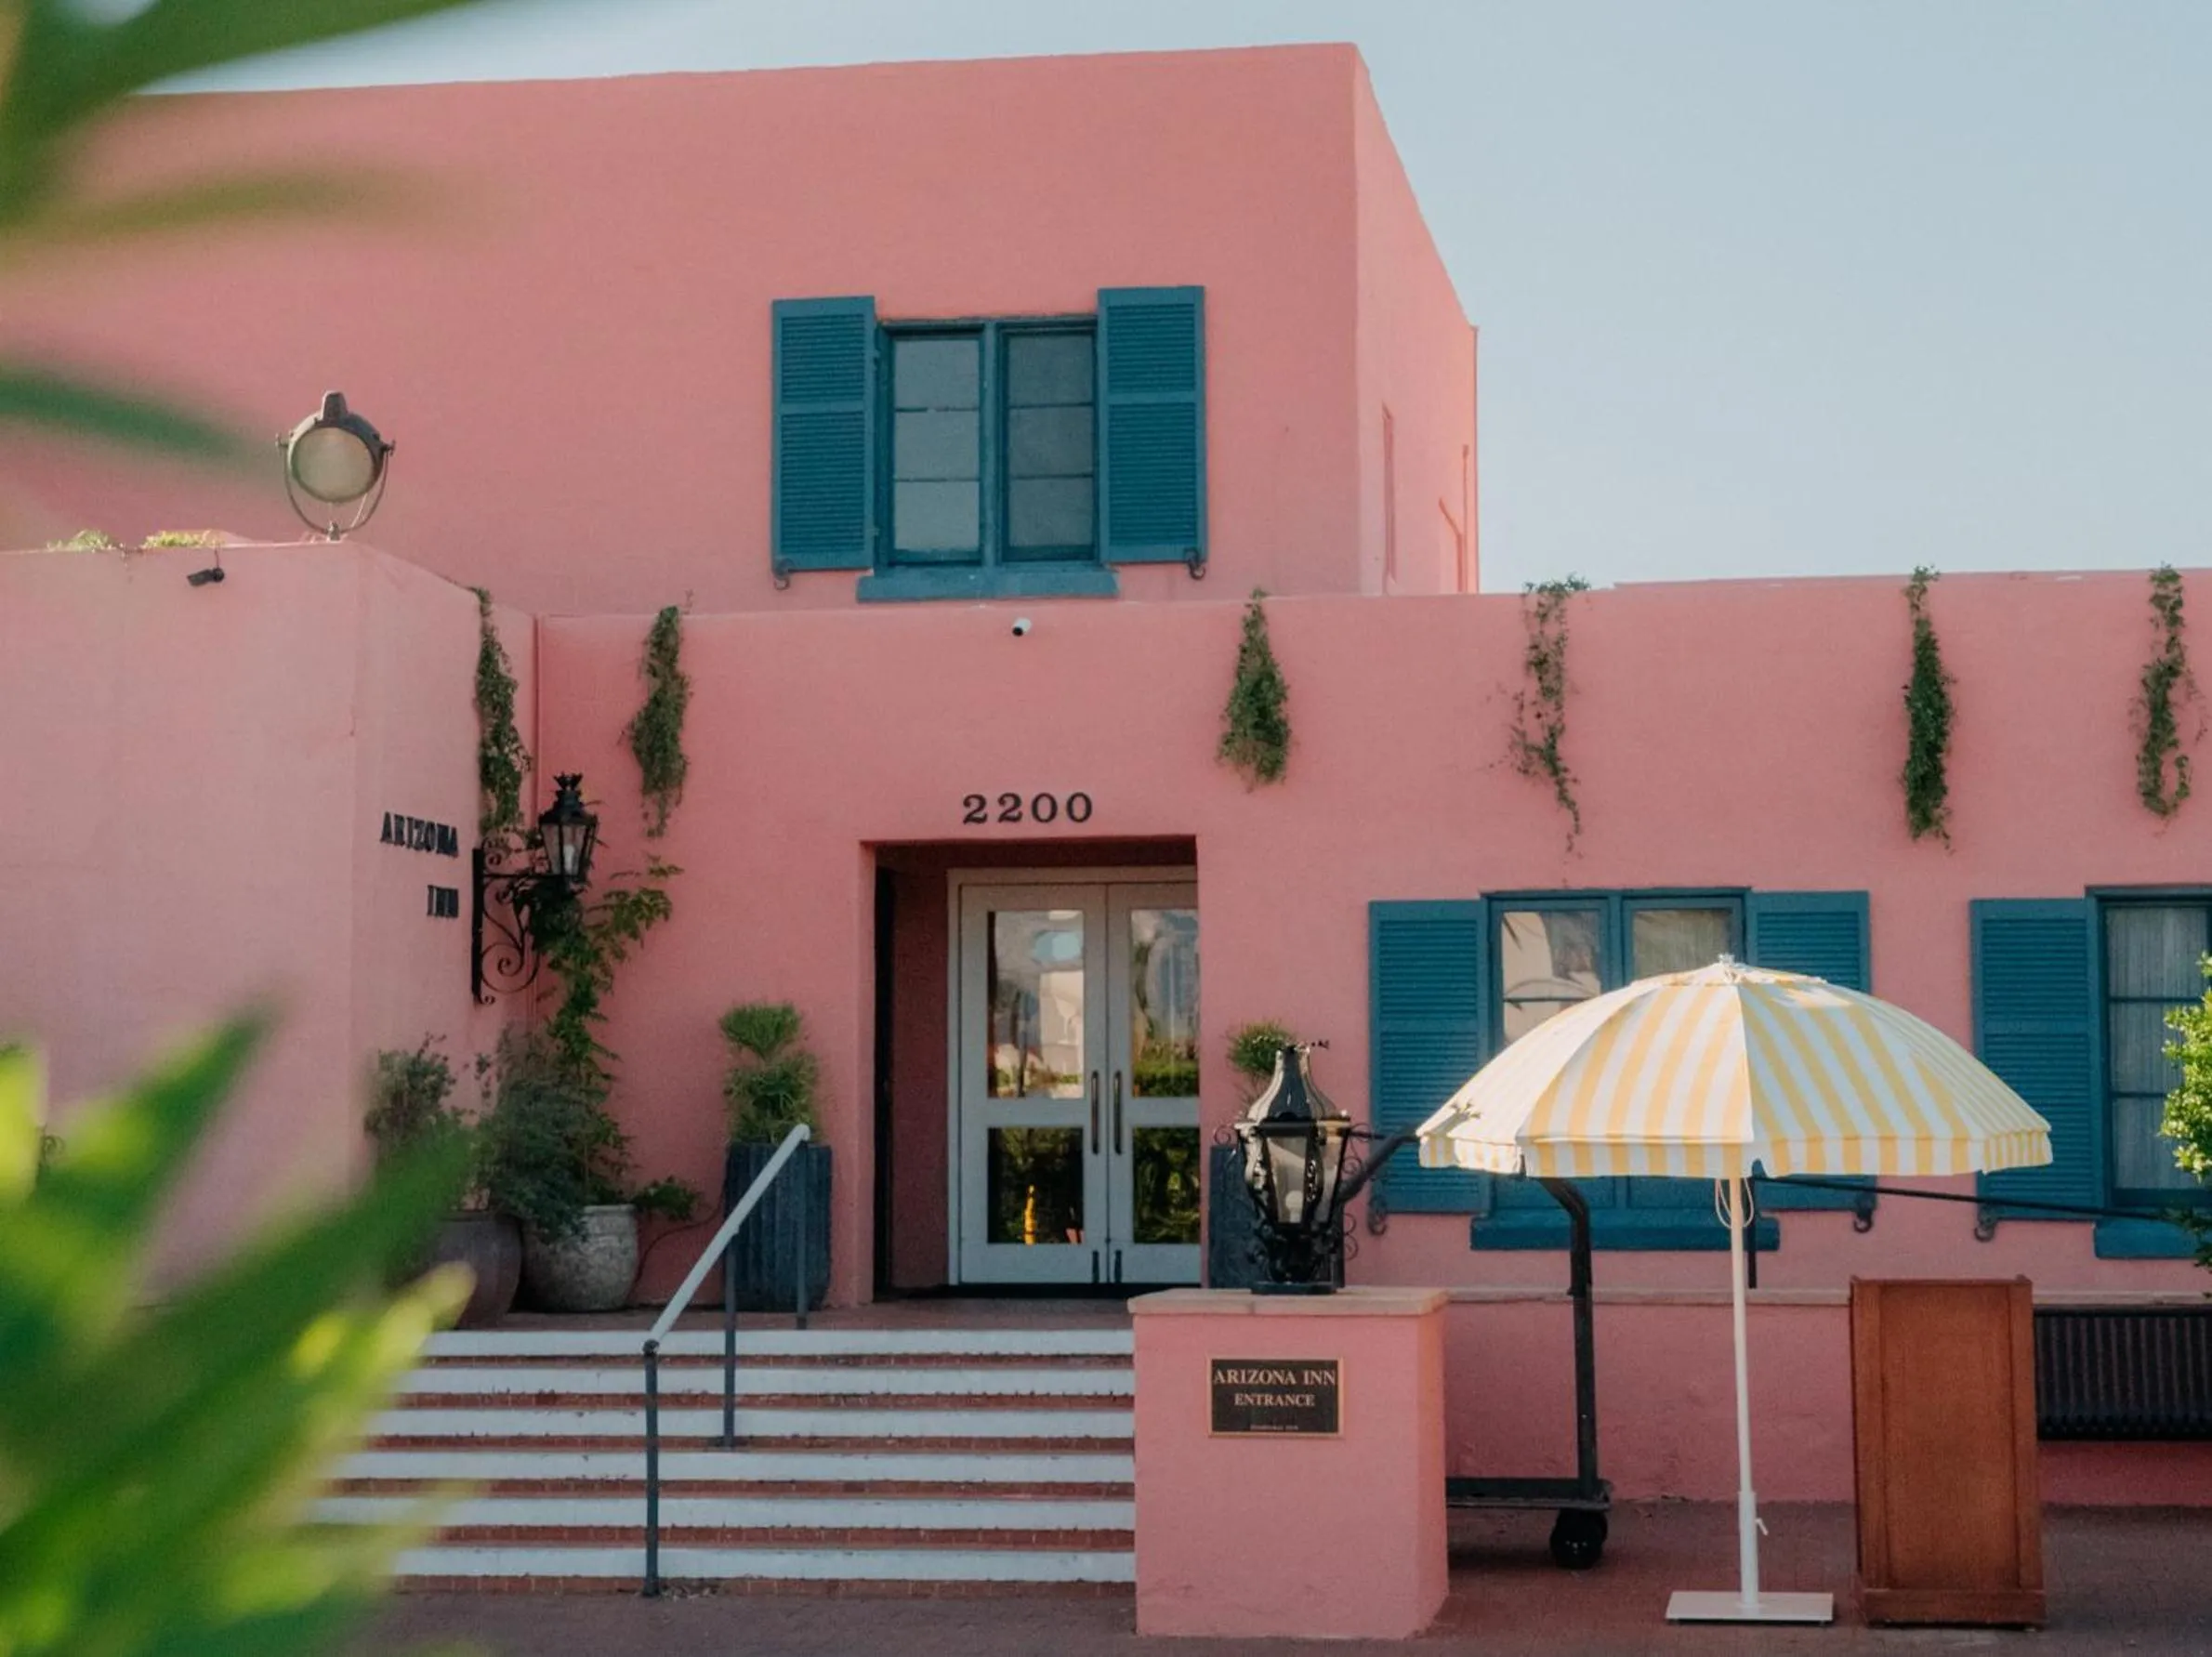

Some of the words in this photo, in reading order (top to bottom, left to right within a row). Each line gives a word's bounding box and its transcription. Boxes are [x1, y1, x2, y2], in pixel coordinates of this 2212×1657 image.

[962, 792, 1093, 825] 2200
[379, 810, 459, 858] ARIZONA
[1213, 1369, 1297, 1386] ARIZONA
[1303, 1369, 1336, 1386] INN
[1234, 1393, 1316, 1407] ENTRANCE
